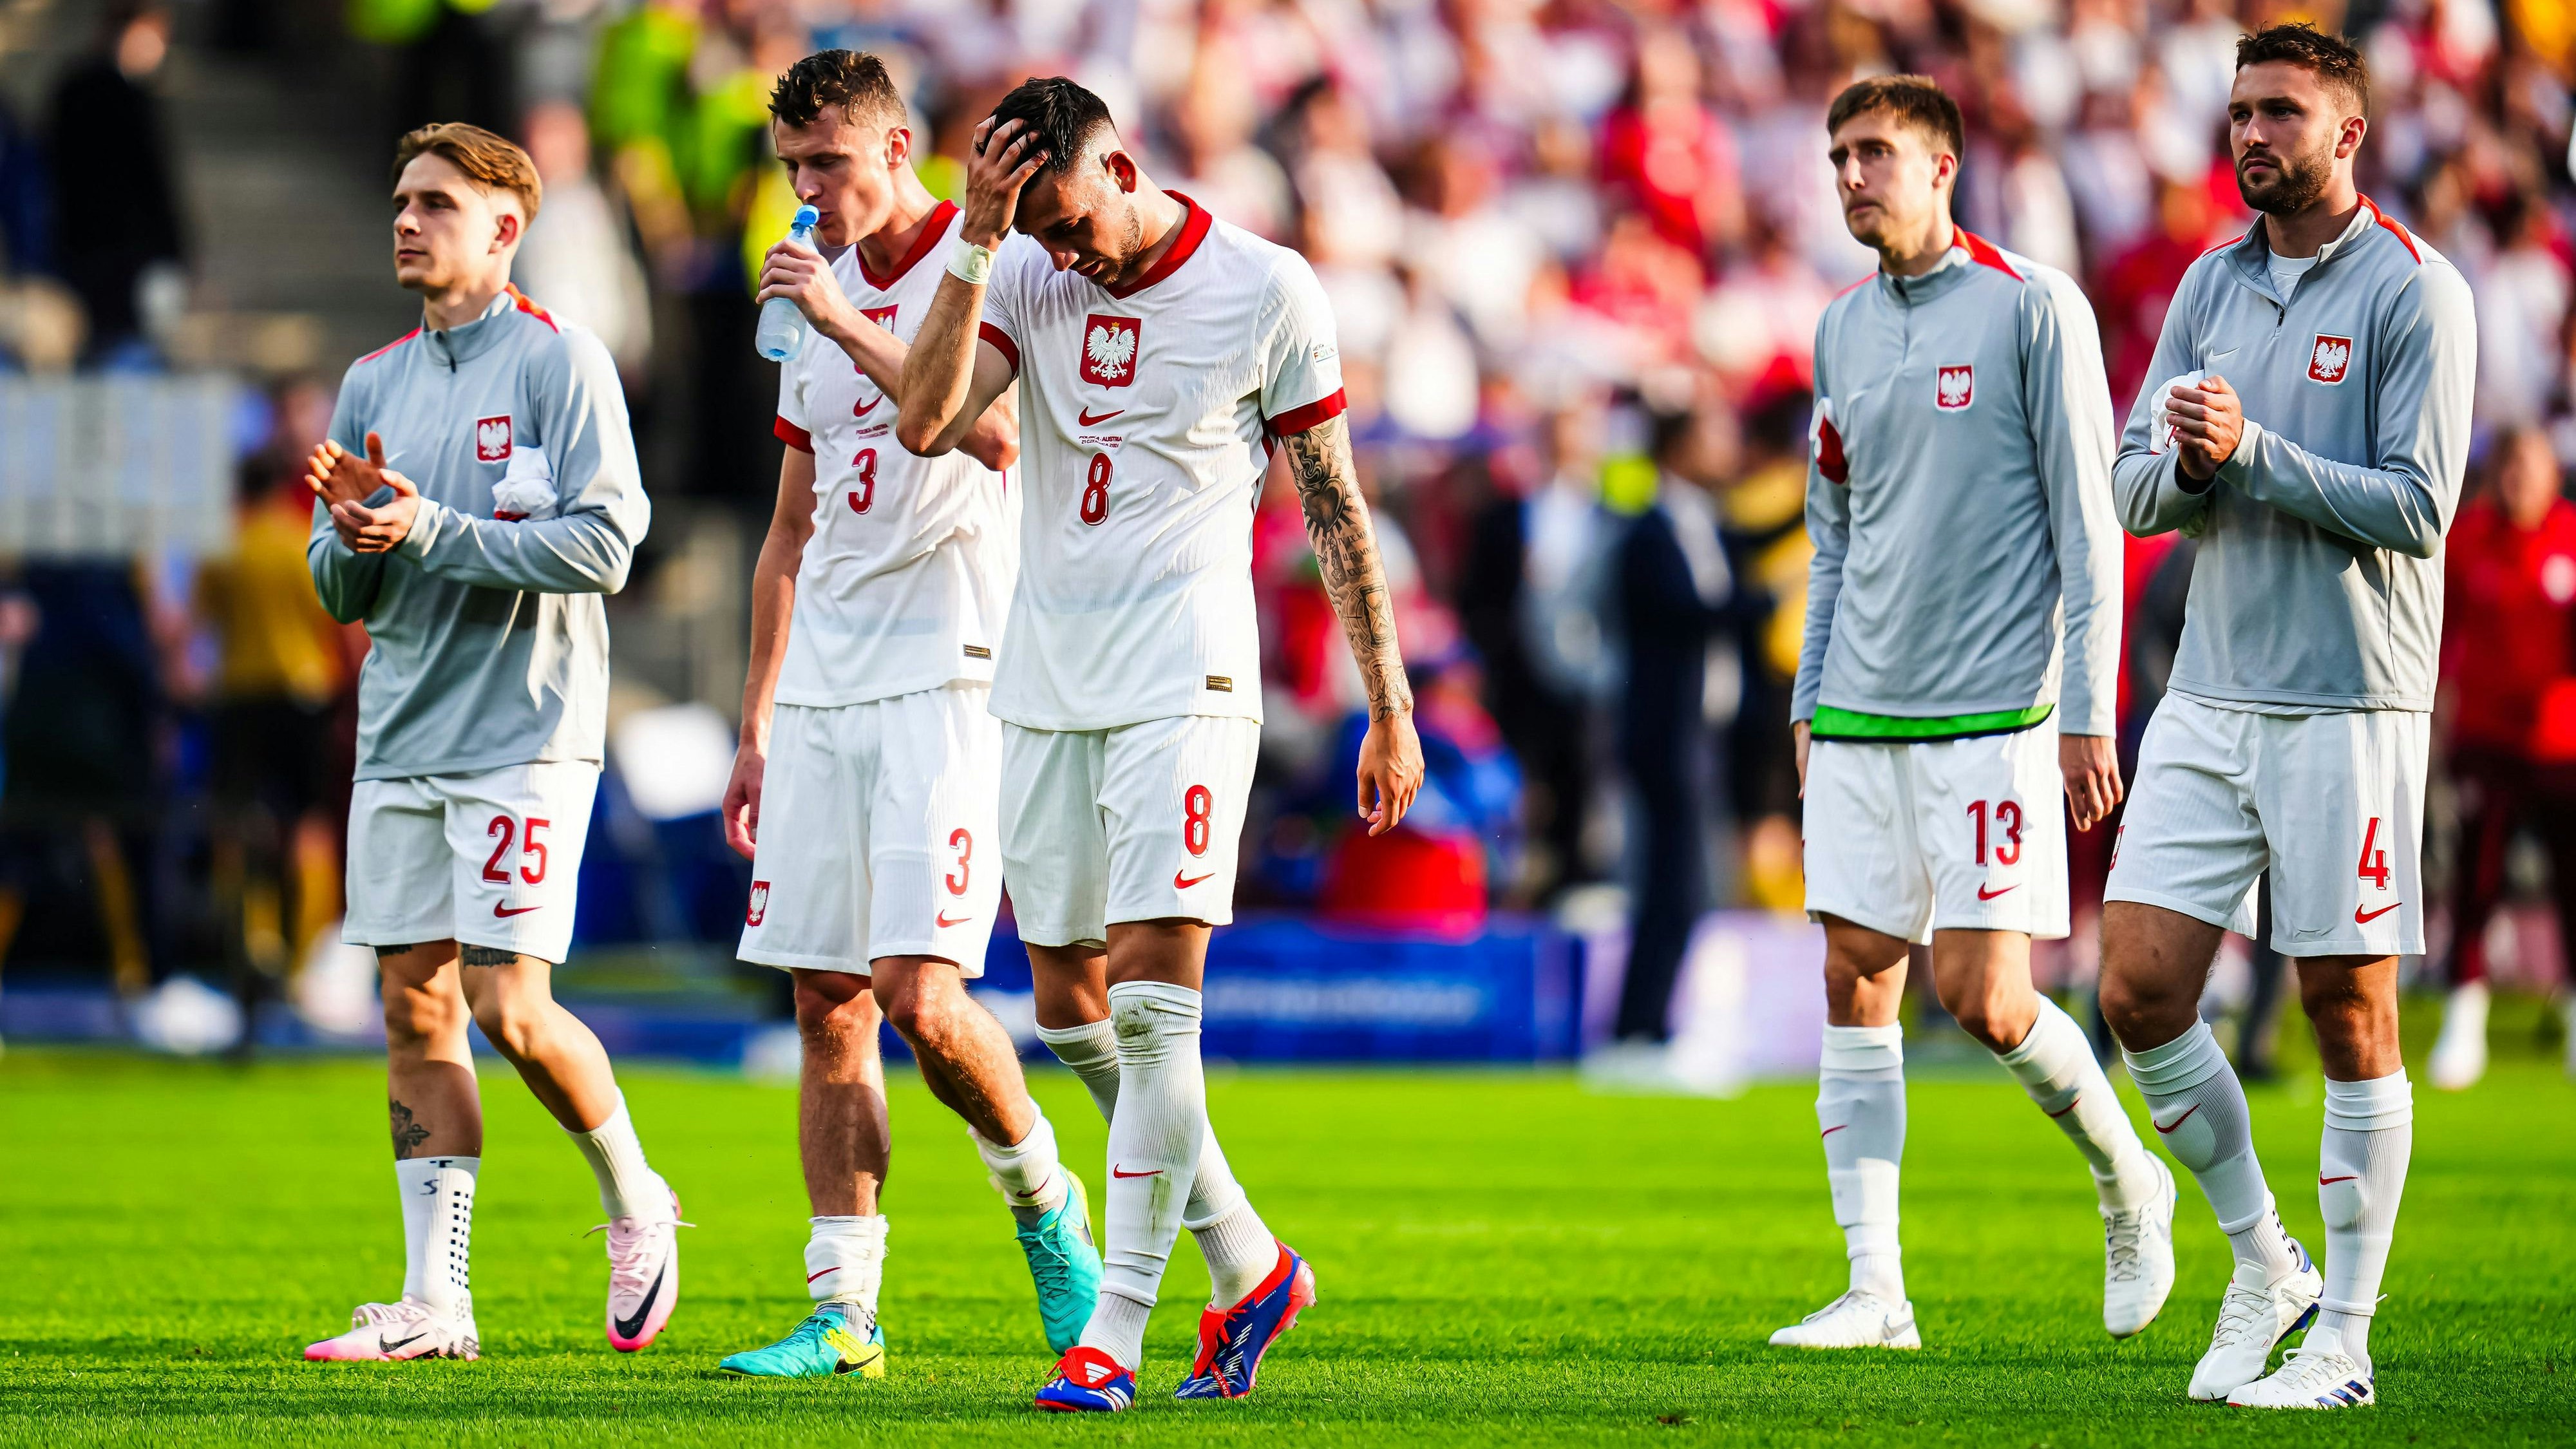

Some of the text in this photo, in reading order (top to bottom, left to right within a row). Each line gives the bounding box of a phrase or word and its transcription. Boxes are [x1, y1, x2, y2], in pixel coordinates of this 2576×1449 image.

[848, 448, 878, 515] 3
[1080, 452, 1113, 525] 8
[482, 815, 551, 887] 25
[1184, 784, 1213, 858] 8
[1966, 799, 2023, 867] 13
[2357, 817, 2391, 890] 4
[945, 828, 973, 898] 3
